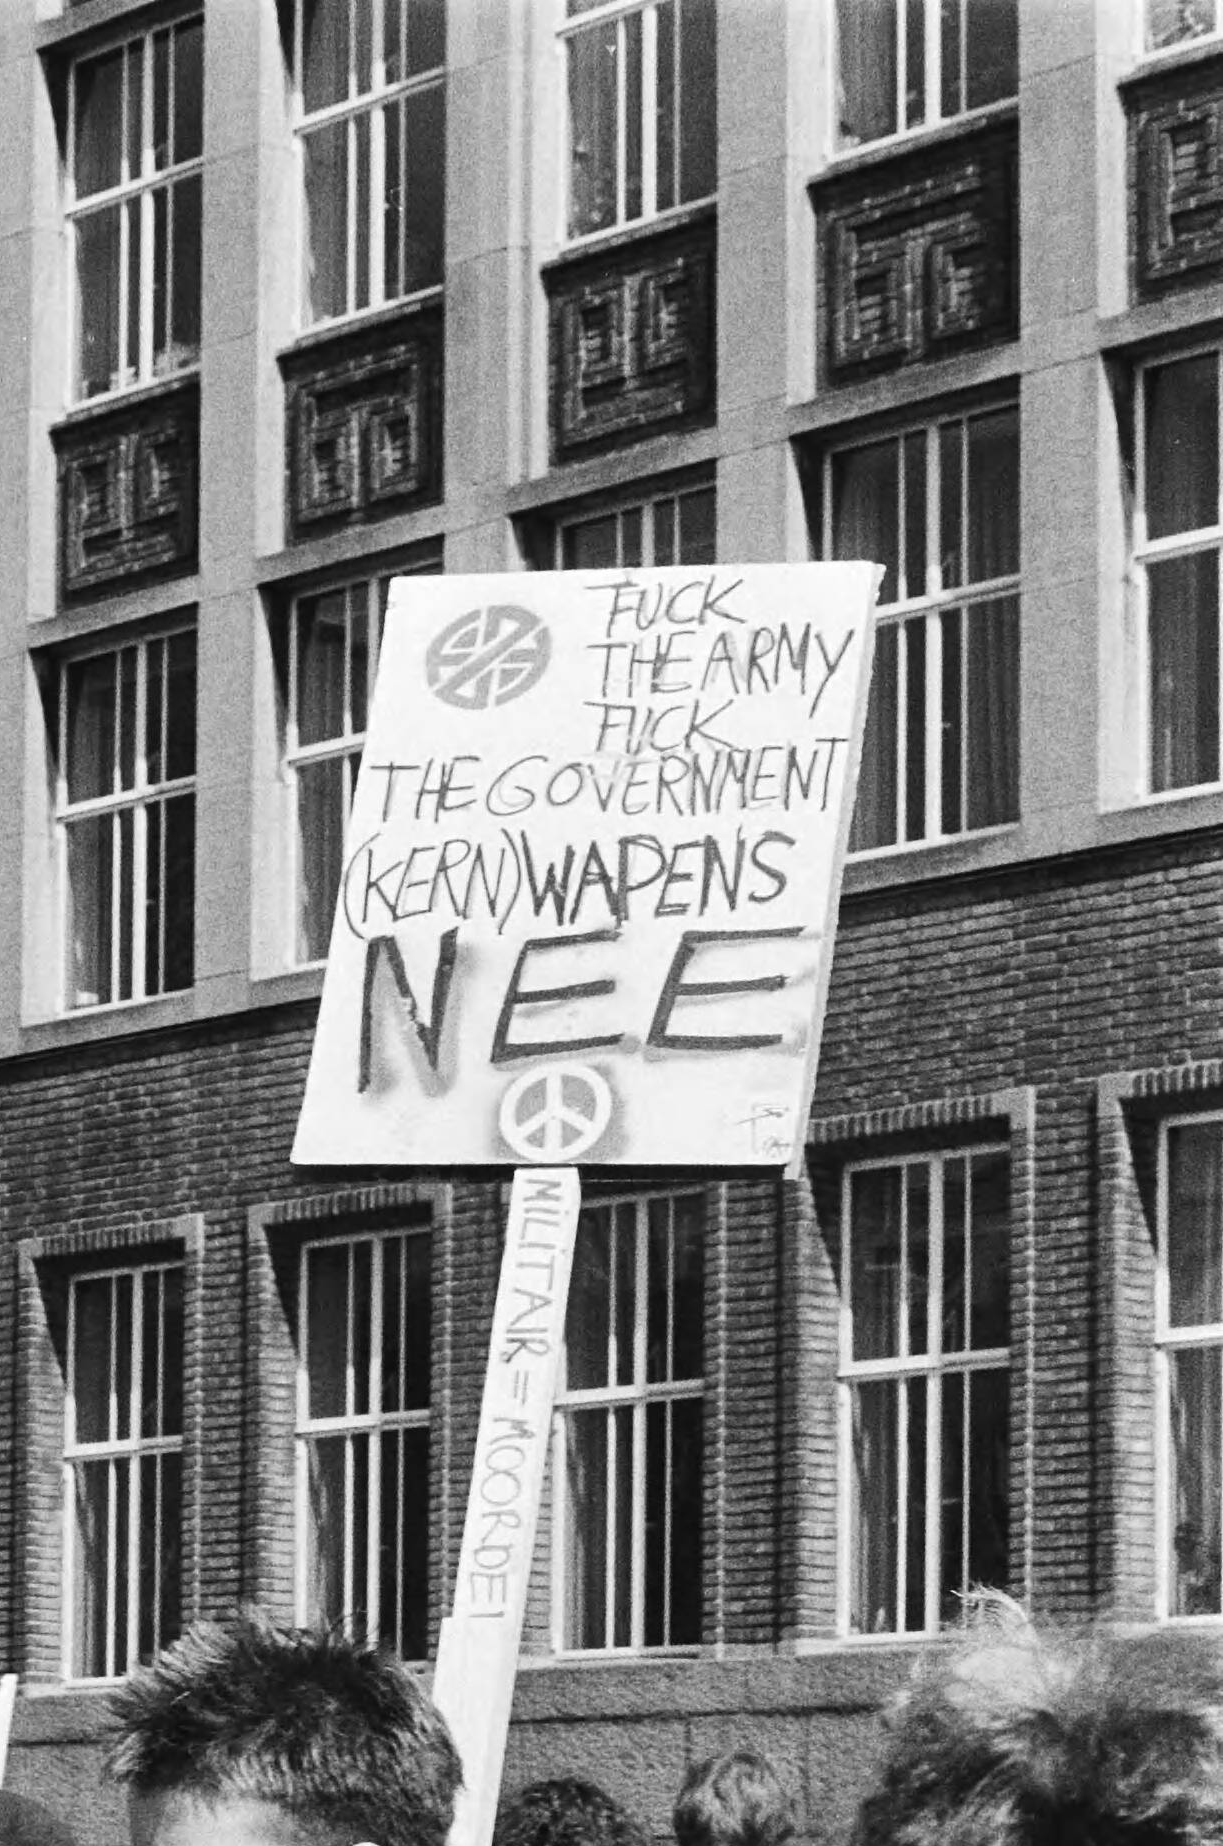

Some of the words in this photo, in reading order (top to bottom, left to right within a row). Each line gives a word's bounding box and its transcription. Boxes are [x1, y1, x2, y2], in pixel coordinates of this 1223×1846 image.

[585, 575, 746, 638] FUCK
[587, 630, 696, 698] THE
[700, 622, 855, 719] ARMY
[584, 699, 740, 756] FUCK
[370, 755, 481, 823] THE
[486, 737, 849, 817] GOVERNMENT
[357, 926, 807, 1094] NEE
